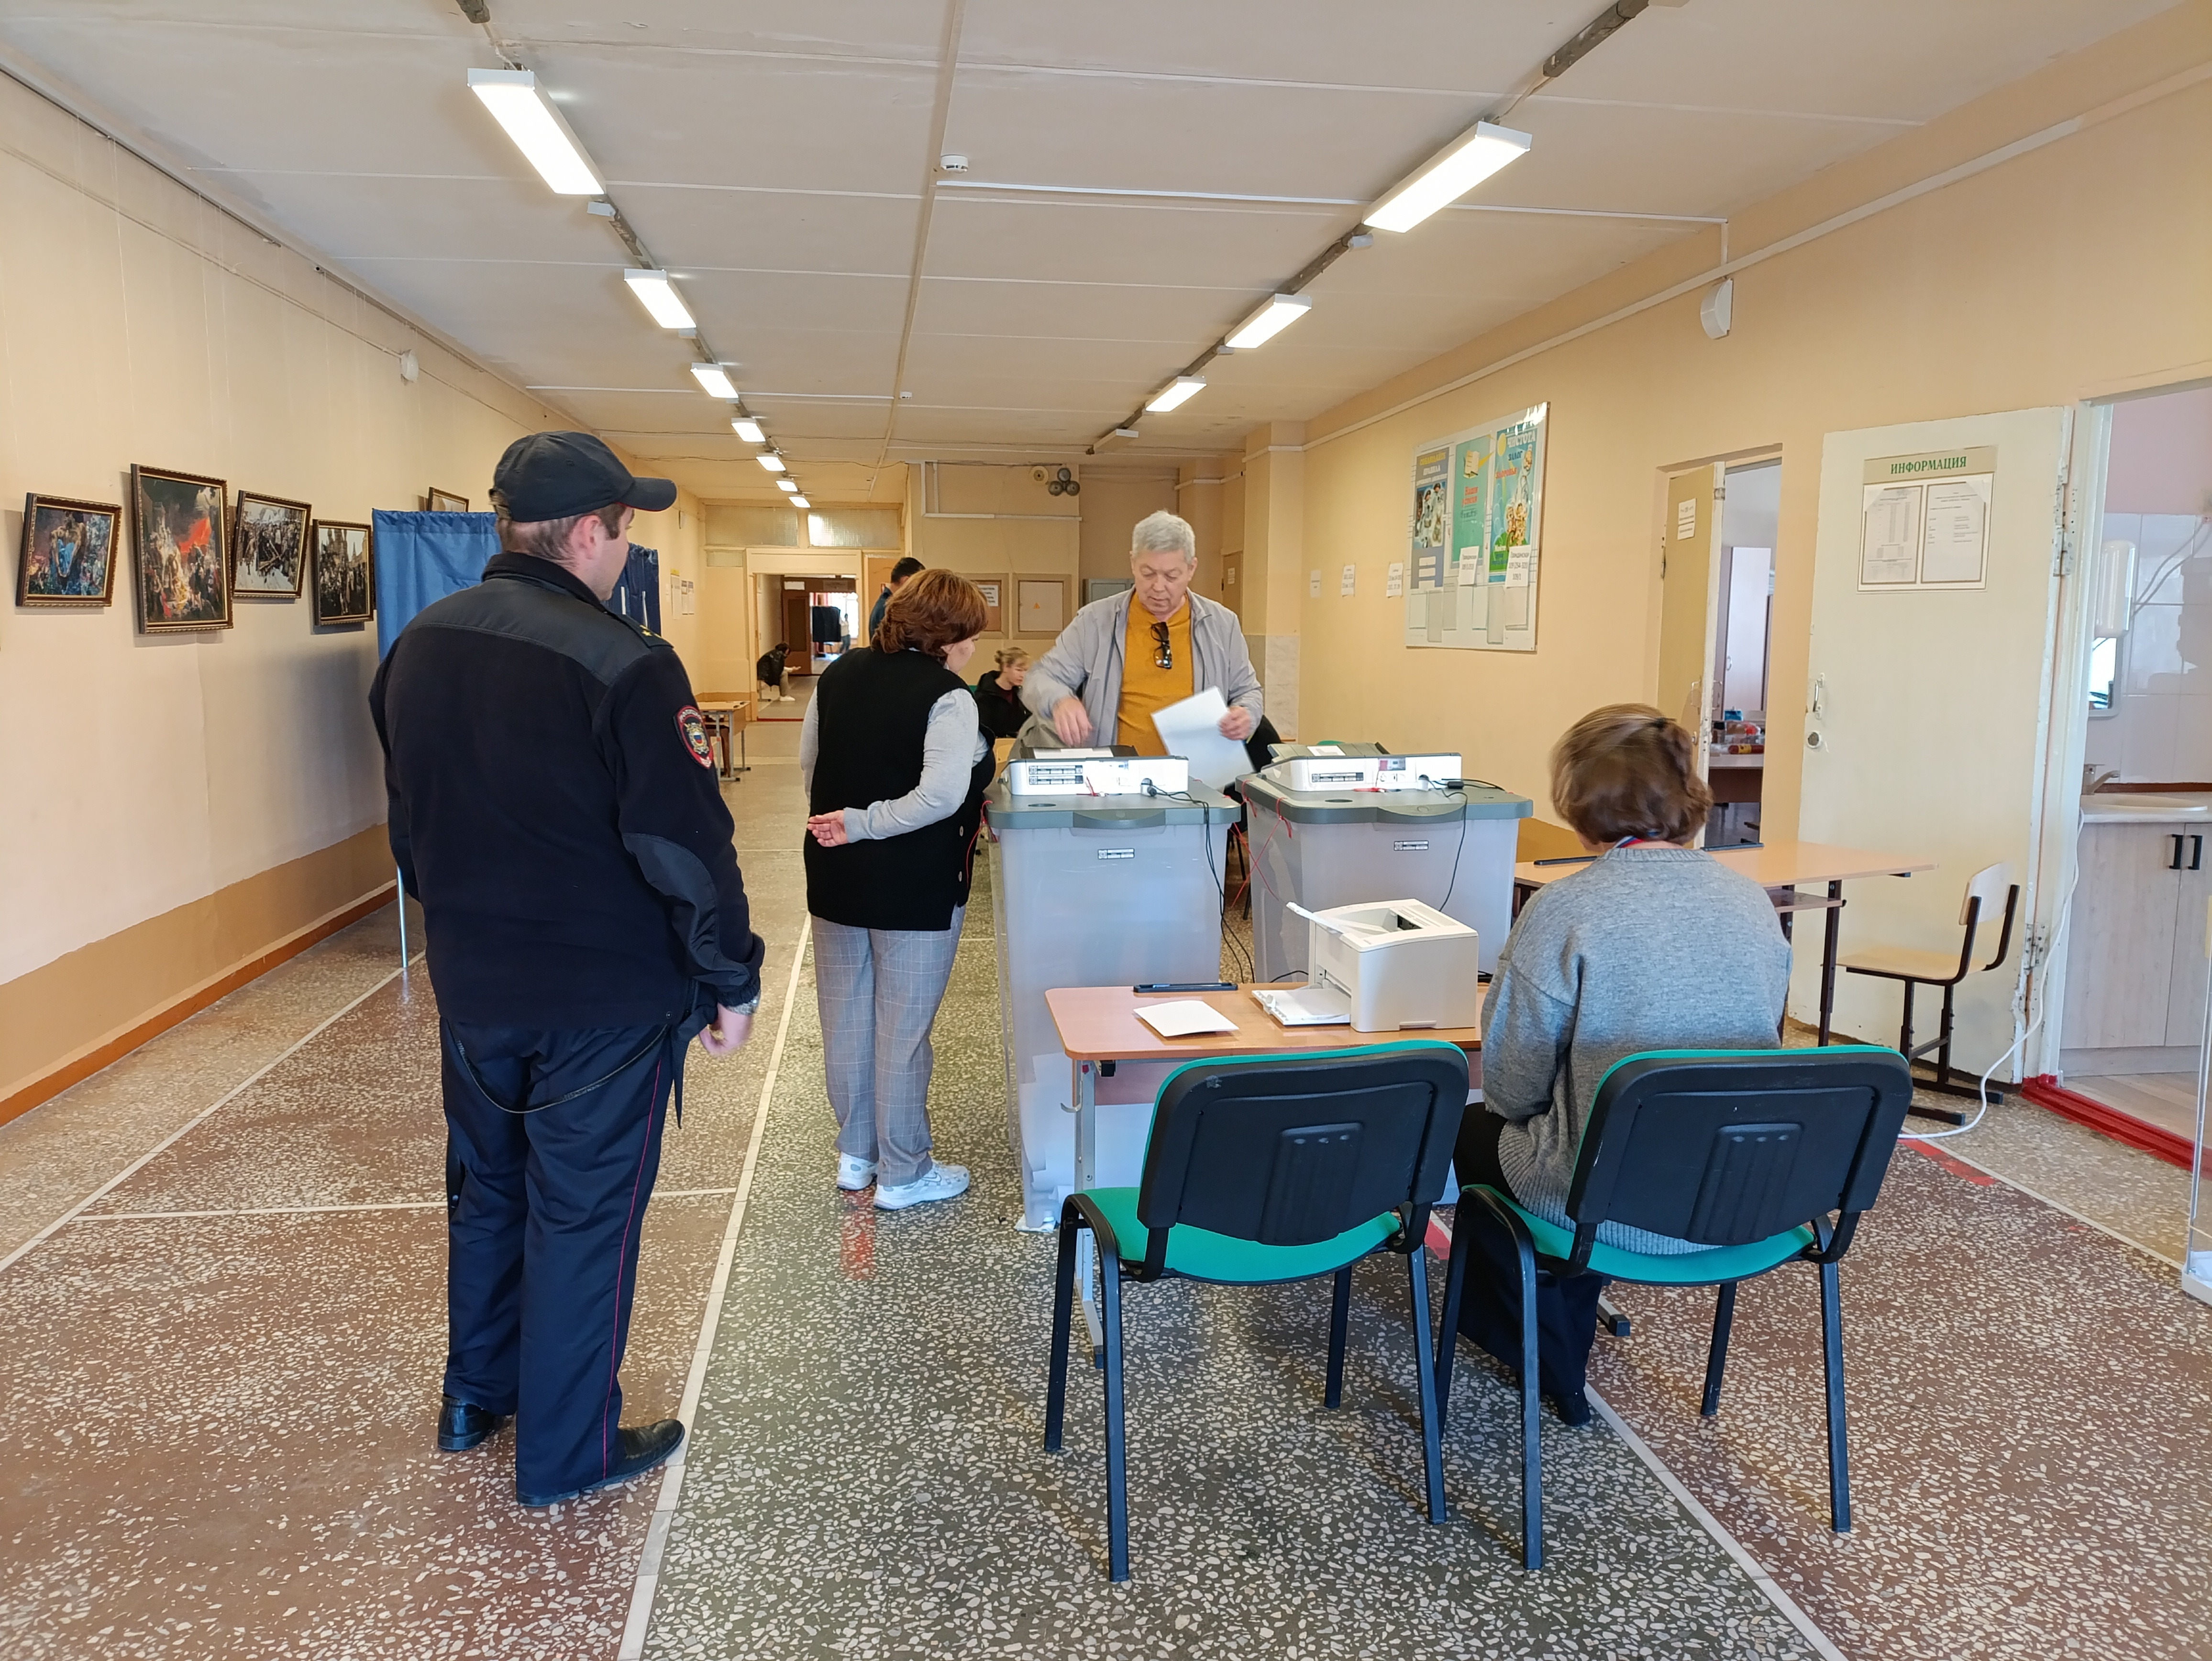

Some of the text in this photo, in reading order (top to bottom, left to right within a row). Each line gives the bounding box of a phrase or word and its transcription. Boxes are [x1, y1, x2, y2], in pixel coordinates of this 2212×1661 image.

[1507, 431, 1536, 448] ЧИСТОТА
[1508, 451, 1523, 461] ЗАЛОГ
[1891, 456, 1967, 475] ИНФОРМАЦИЯ
